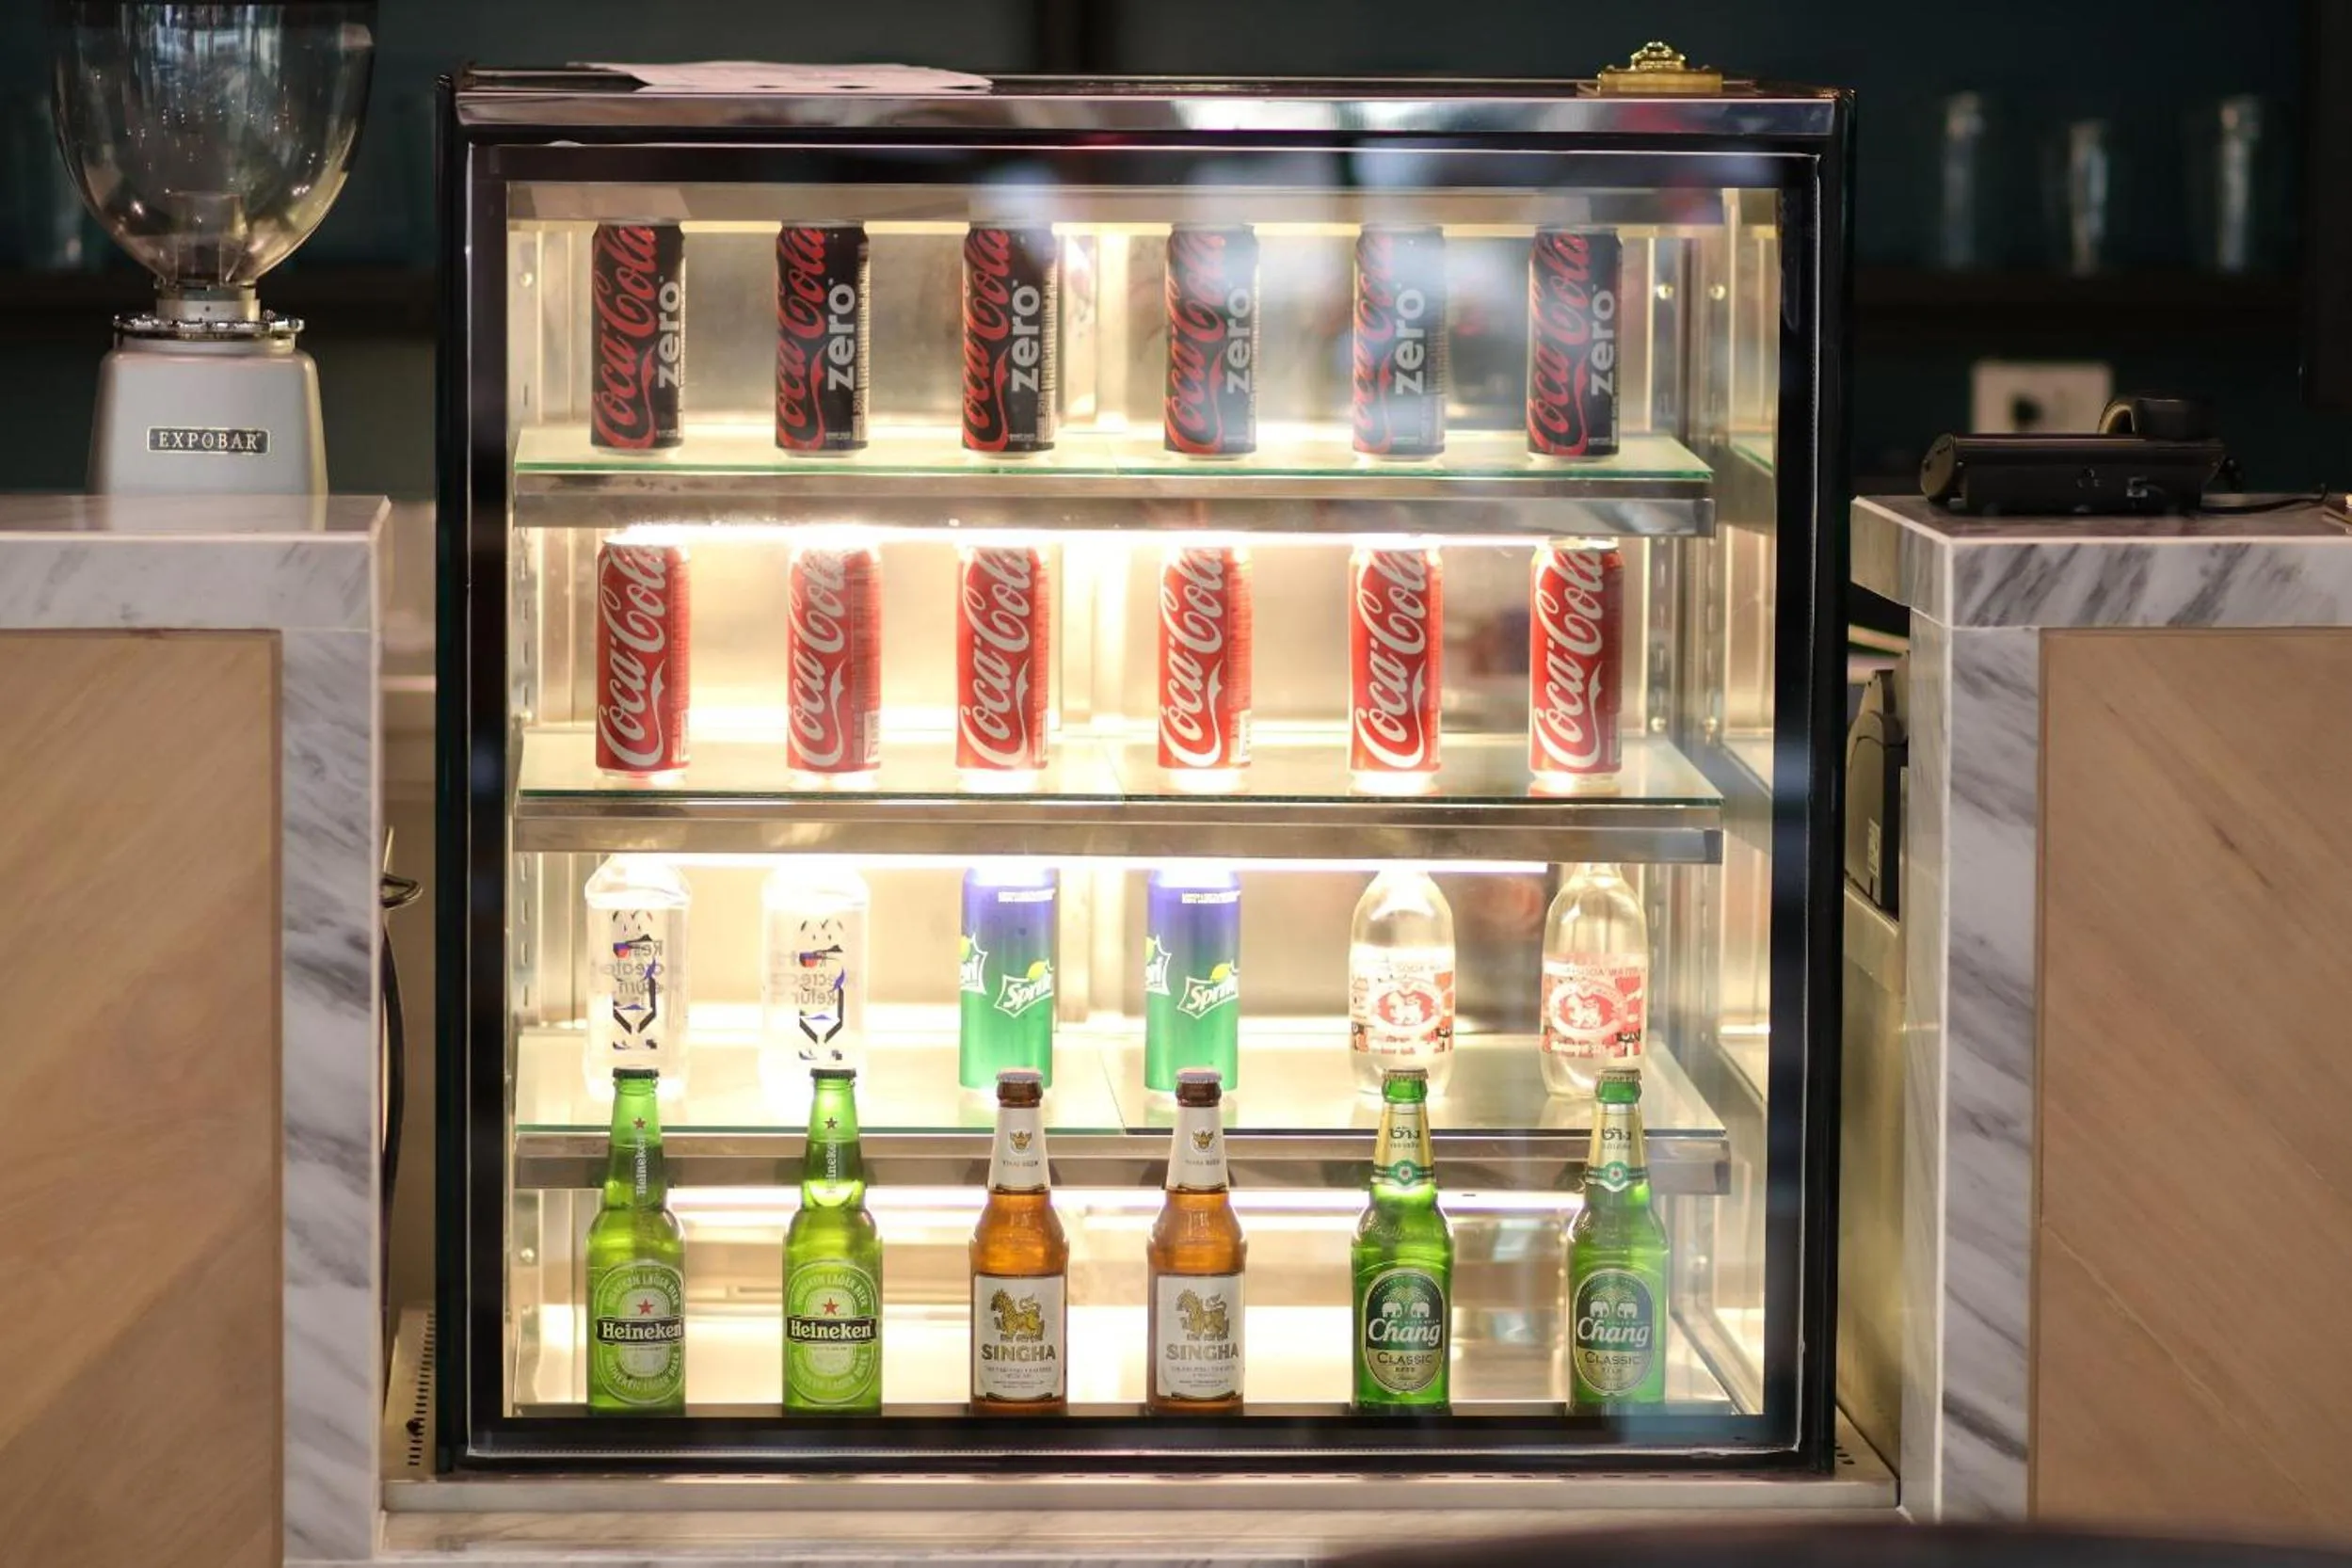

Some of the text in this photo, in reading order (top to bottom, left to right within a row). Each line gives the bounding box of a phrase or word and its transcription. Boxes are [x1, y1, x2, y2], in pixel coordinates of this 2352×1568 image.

[658, 280, 681, 389] zero
[827, 283, 856, 391] zero
[1011, 284, 1040, 392] zero
[1226, 288, 1251, 394] zero
[1395, 288, 1426, 395] zero
[1590, 290, 1616, 396] zero
[158, 432, 259, 450] EXPOBAR
[1003, 970, 1052, 1011] Sprit
[1186, 973, 1237, 1012] Sprit
[602, 1321, 681, 1340] Heineken
[791, 1320, 872, 1340] Heineken
[1368, 1318, 1441, 1347] Chang
[1576, 1317, 1649, 1348] Chang
[982, 1343, 1056, 1362] SINGHA
[1166, 1343, 1240, 1361] SINGHA
[1377, 1352, 1432, 1365] CLASSIC
[1585, 1351, 1642, 1365] CLASSIC
